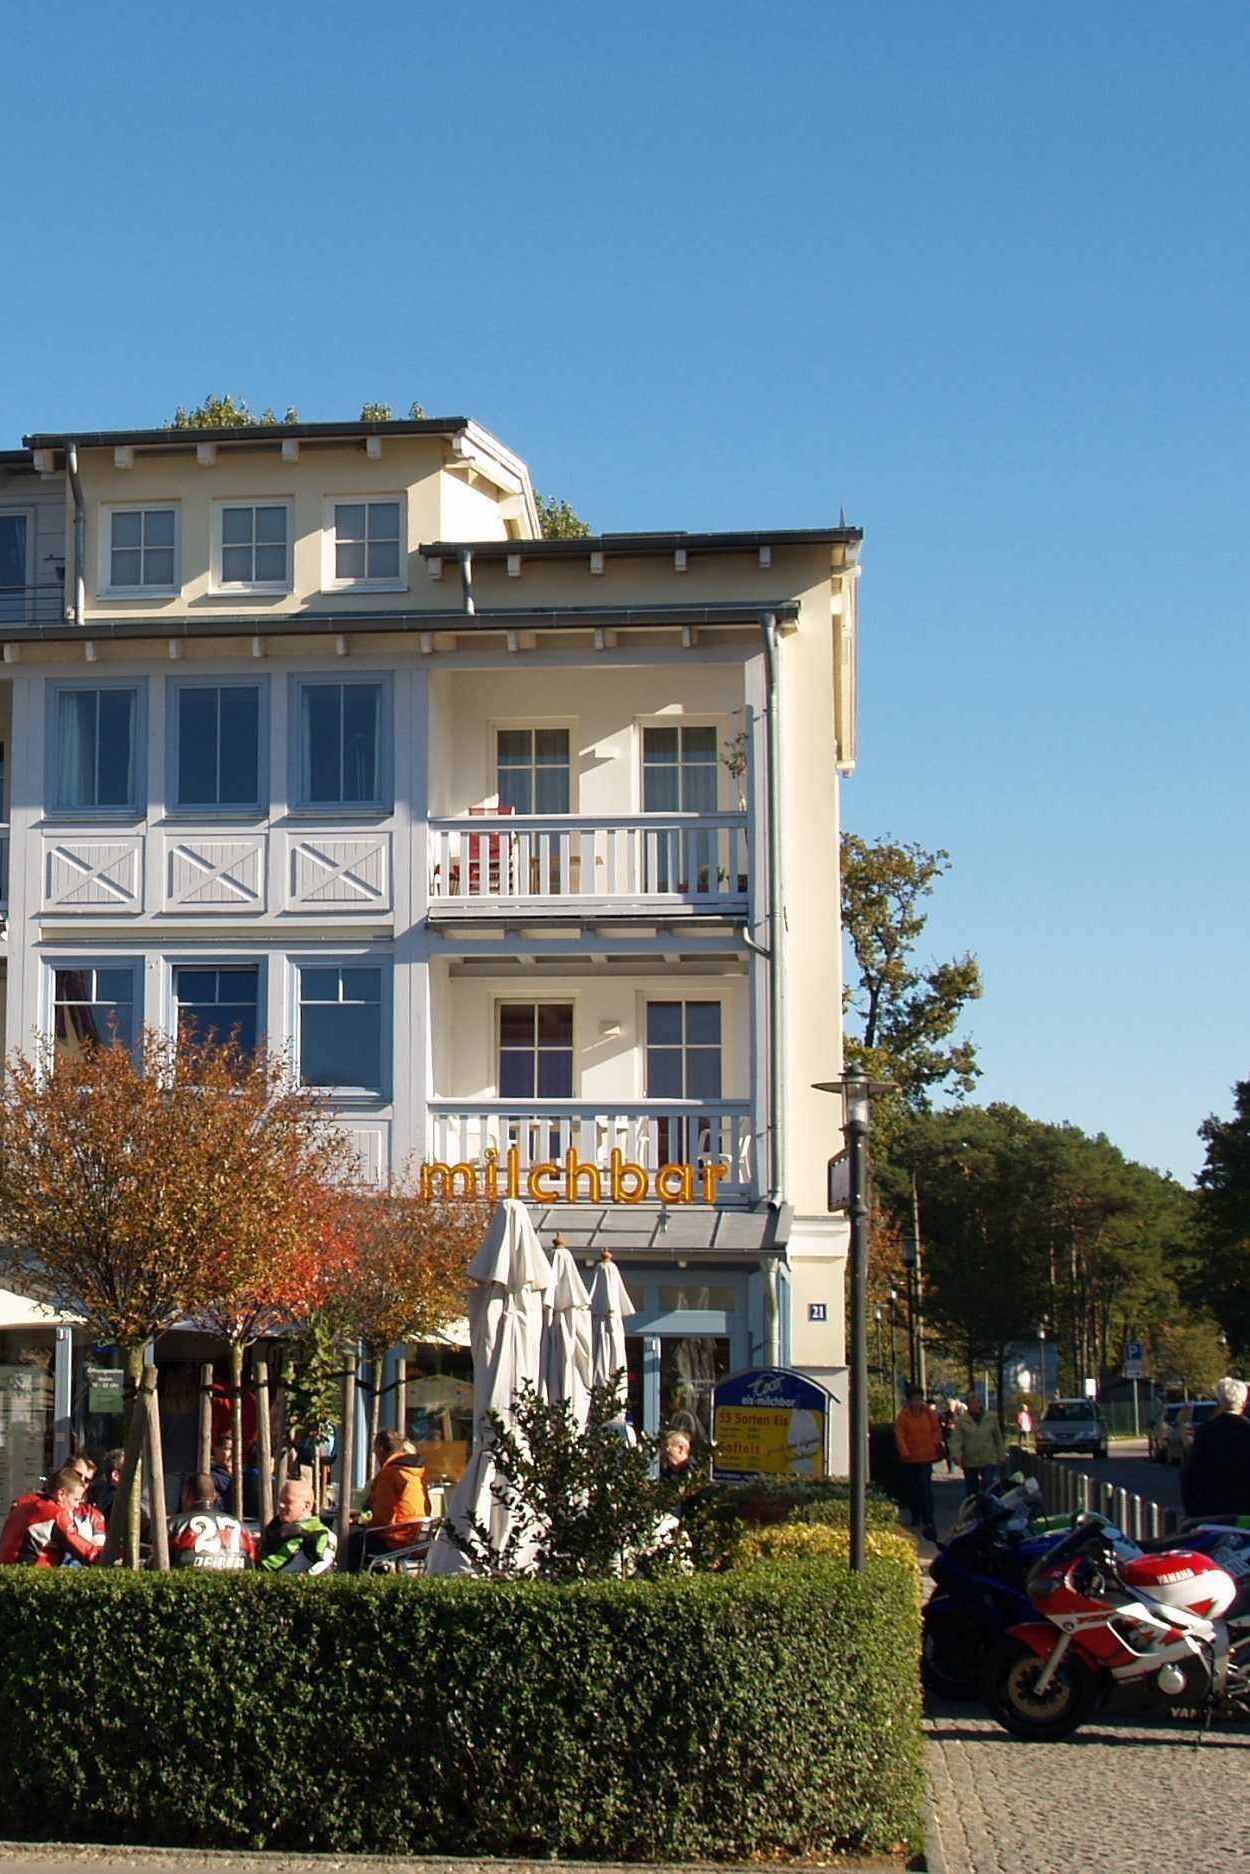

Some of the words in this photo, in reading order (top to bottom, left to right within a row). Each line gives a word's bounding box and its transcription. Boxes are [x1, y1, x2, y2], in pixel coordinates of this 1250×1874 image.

[420, 1147, 728, 1204] milchbar
[811, 1306, 824, 1319] 21
[1128, 1344, 1138, 1358] P
[735, 1413, 770, 1425] Sorten
[773, 1414, 788, 1426] Eis
[190, 1515, 242, 1553] 27
[1156, 1567, 1195, 1585] YAMAHA
